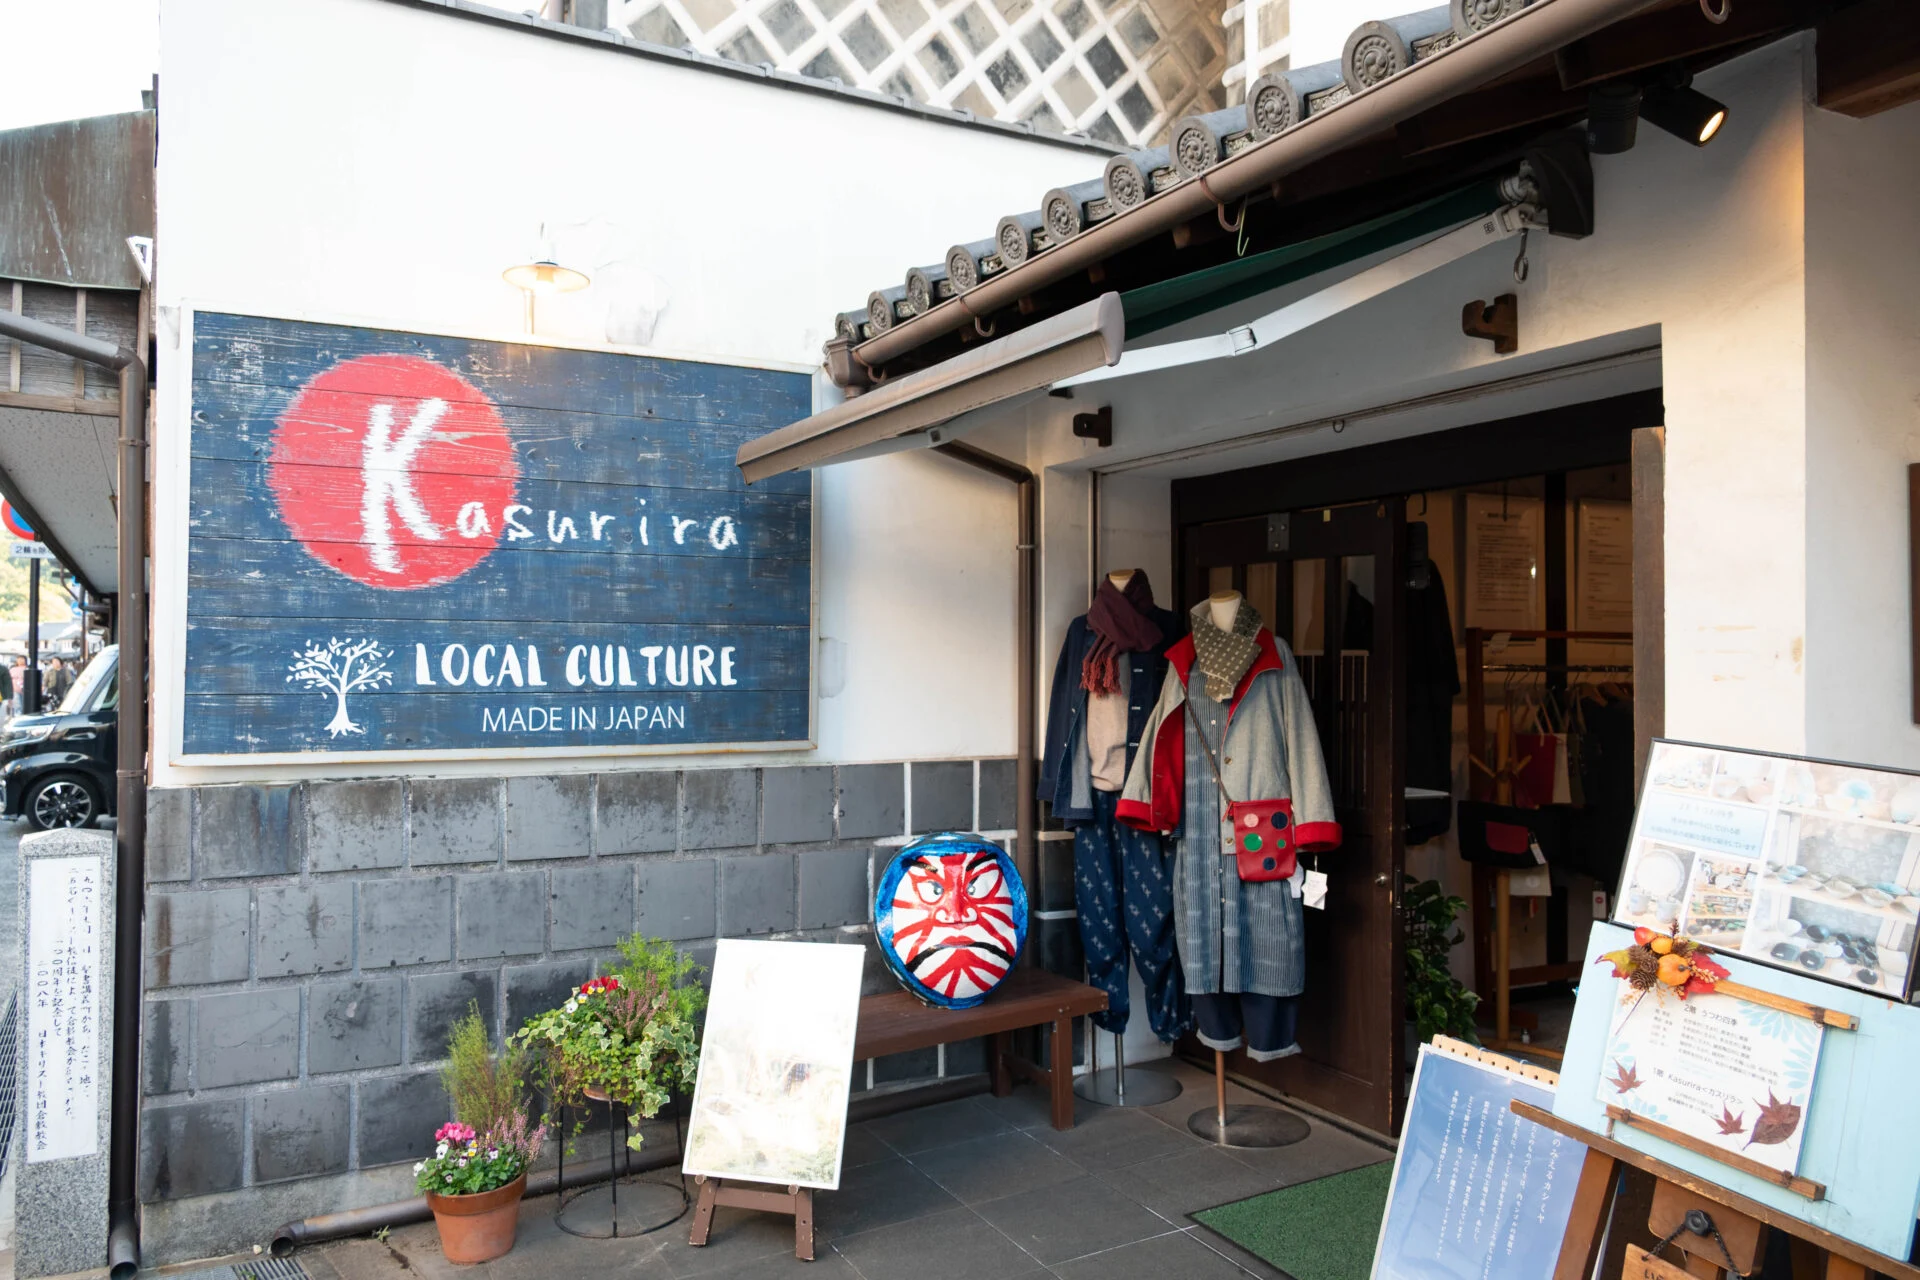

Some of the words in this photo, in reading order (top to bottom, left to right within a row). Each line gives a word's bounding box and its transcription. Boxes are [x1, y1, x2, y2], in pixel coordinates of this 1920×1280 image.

[359, 397, 739, 574] Kasurira
[415, 643, 548, 687] LOCAL
[565, 645, 738, 687] CULTURE
[481, 706, 561, 733] MADE
[570, 706, 597, 730] IN
[604, 704, 686, 730] JAPAN
